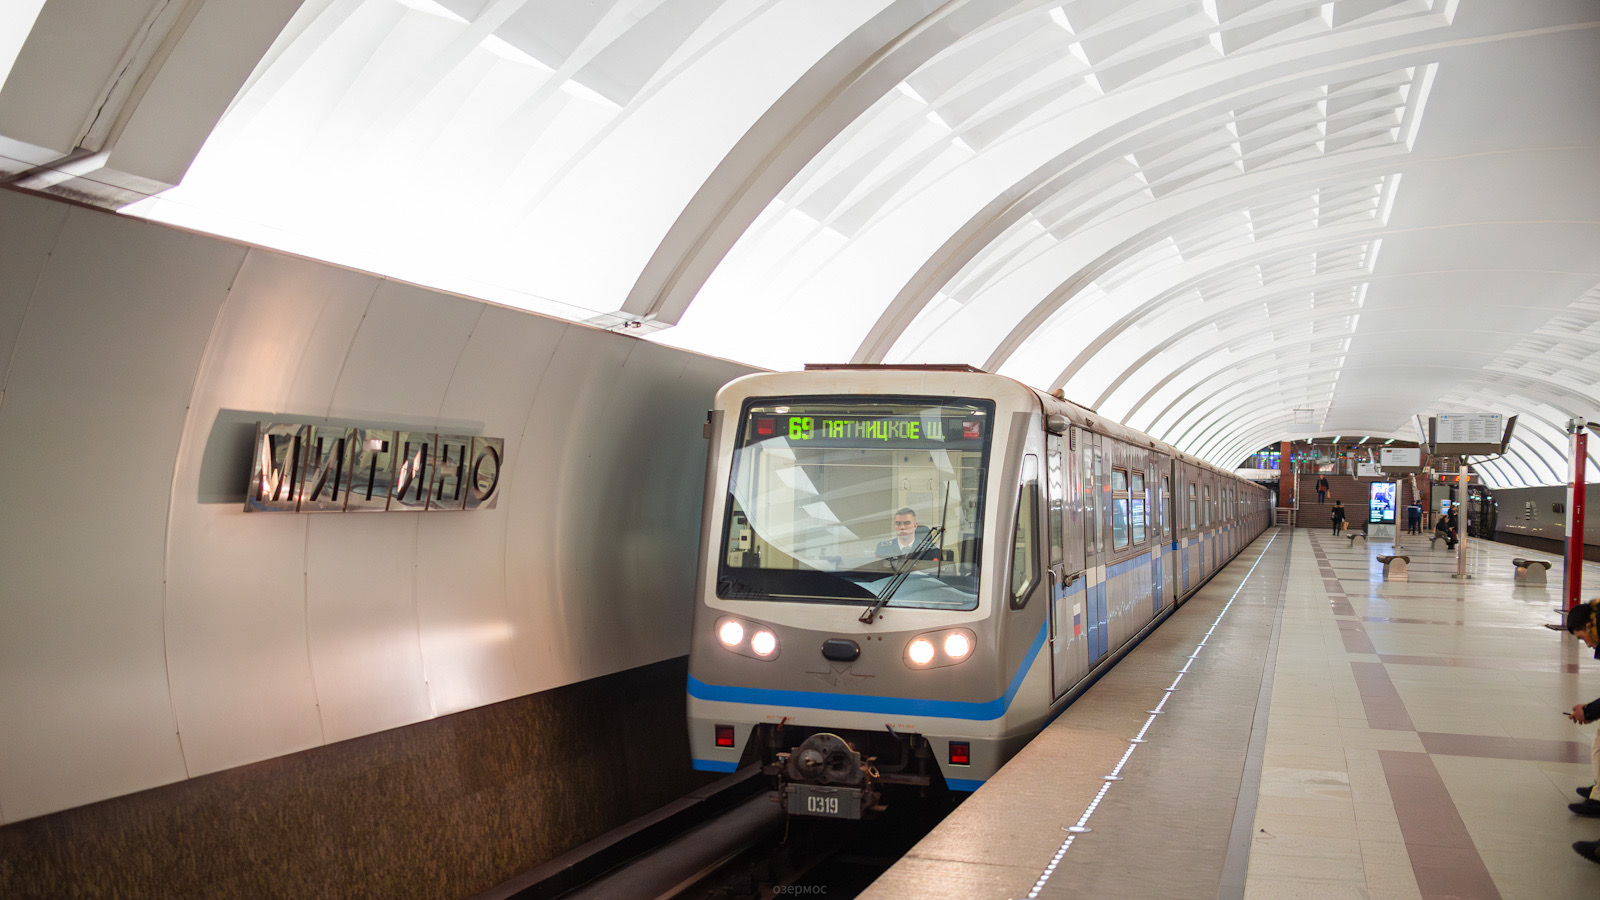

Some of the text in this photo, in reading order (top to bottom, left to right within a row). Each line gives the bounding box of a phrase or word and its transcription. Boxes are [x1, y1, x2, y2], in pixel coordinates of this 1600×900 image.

[788, 416, 815, 440] 69
[821, 419, 920, 442] ПЯТНИЦКОЕ
[256, 432, 500, 502] МИТИНО
[807, 796, 839, 814] 0319
